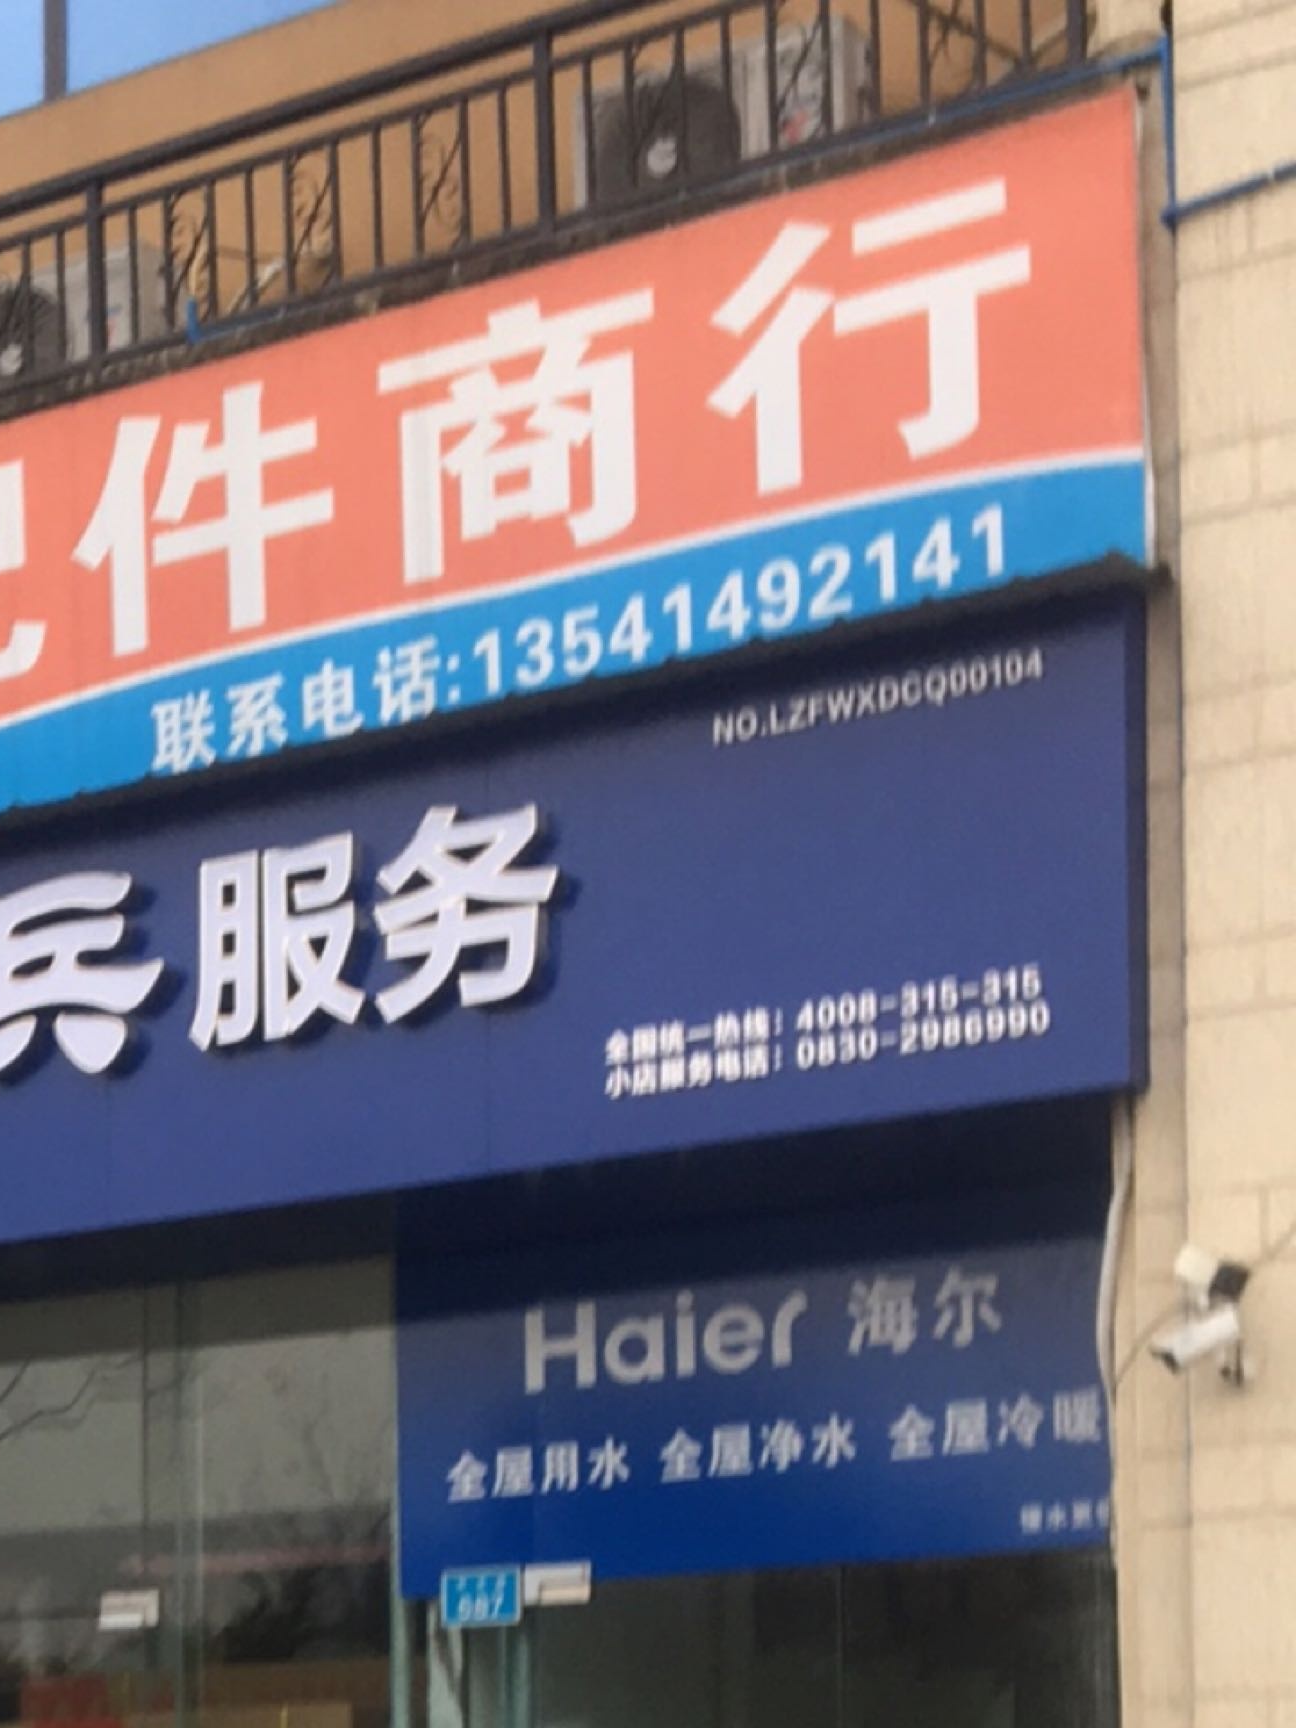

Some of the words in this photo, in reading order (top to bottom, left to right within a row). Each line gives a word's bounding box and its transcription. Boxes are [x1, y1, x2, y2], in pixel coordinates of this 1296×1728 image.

[524, 1290, 807, 1393] Haier
[846, 1266, 1002, 1356] 海尔
[446, 1437, 631, 1503] 全屋用水
[660, 1415, 857, 1484] 全屋净水
